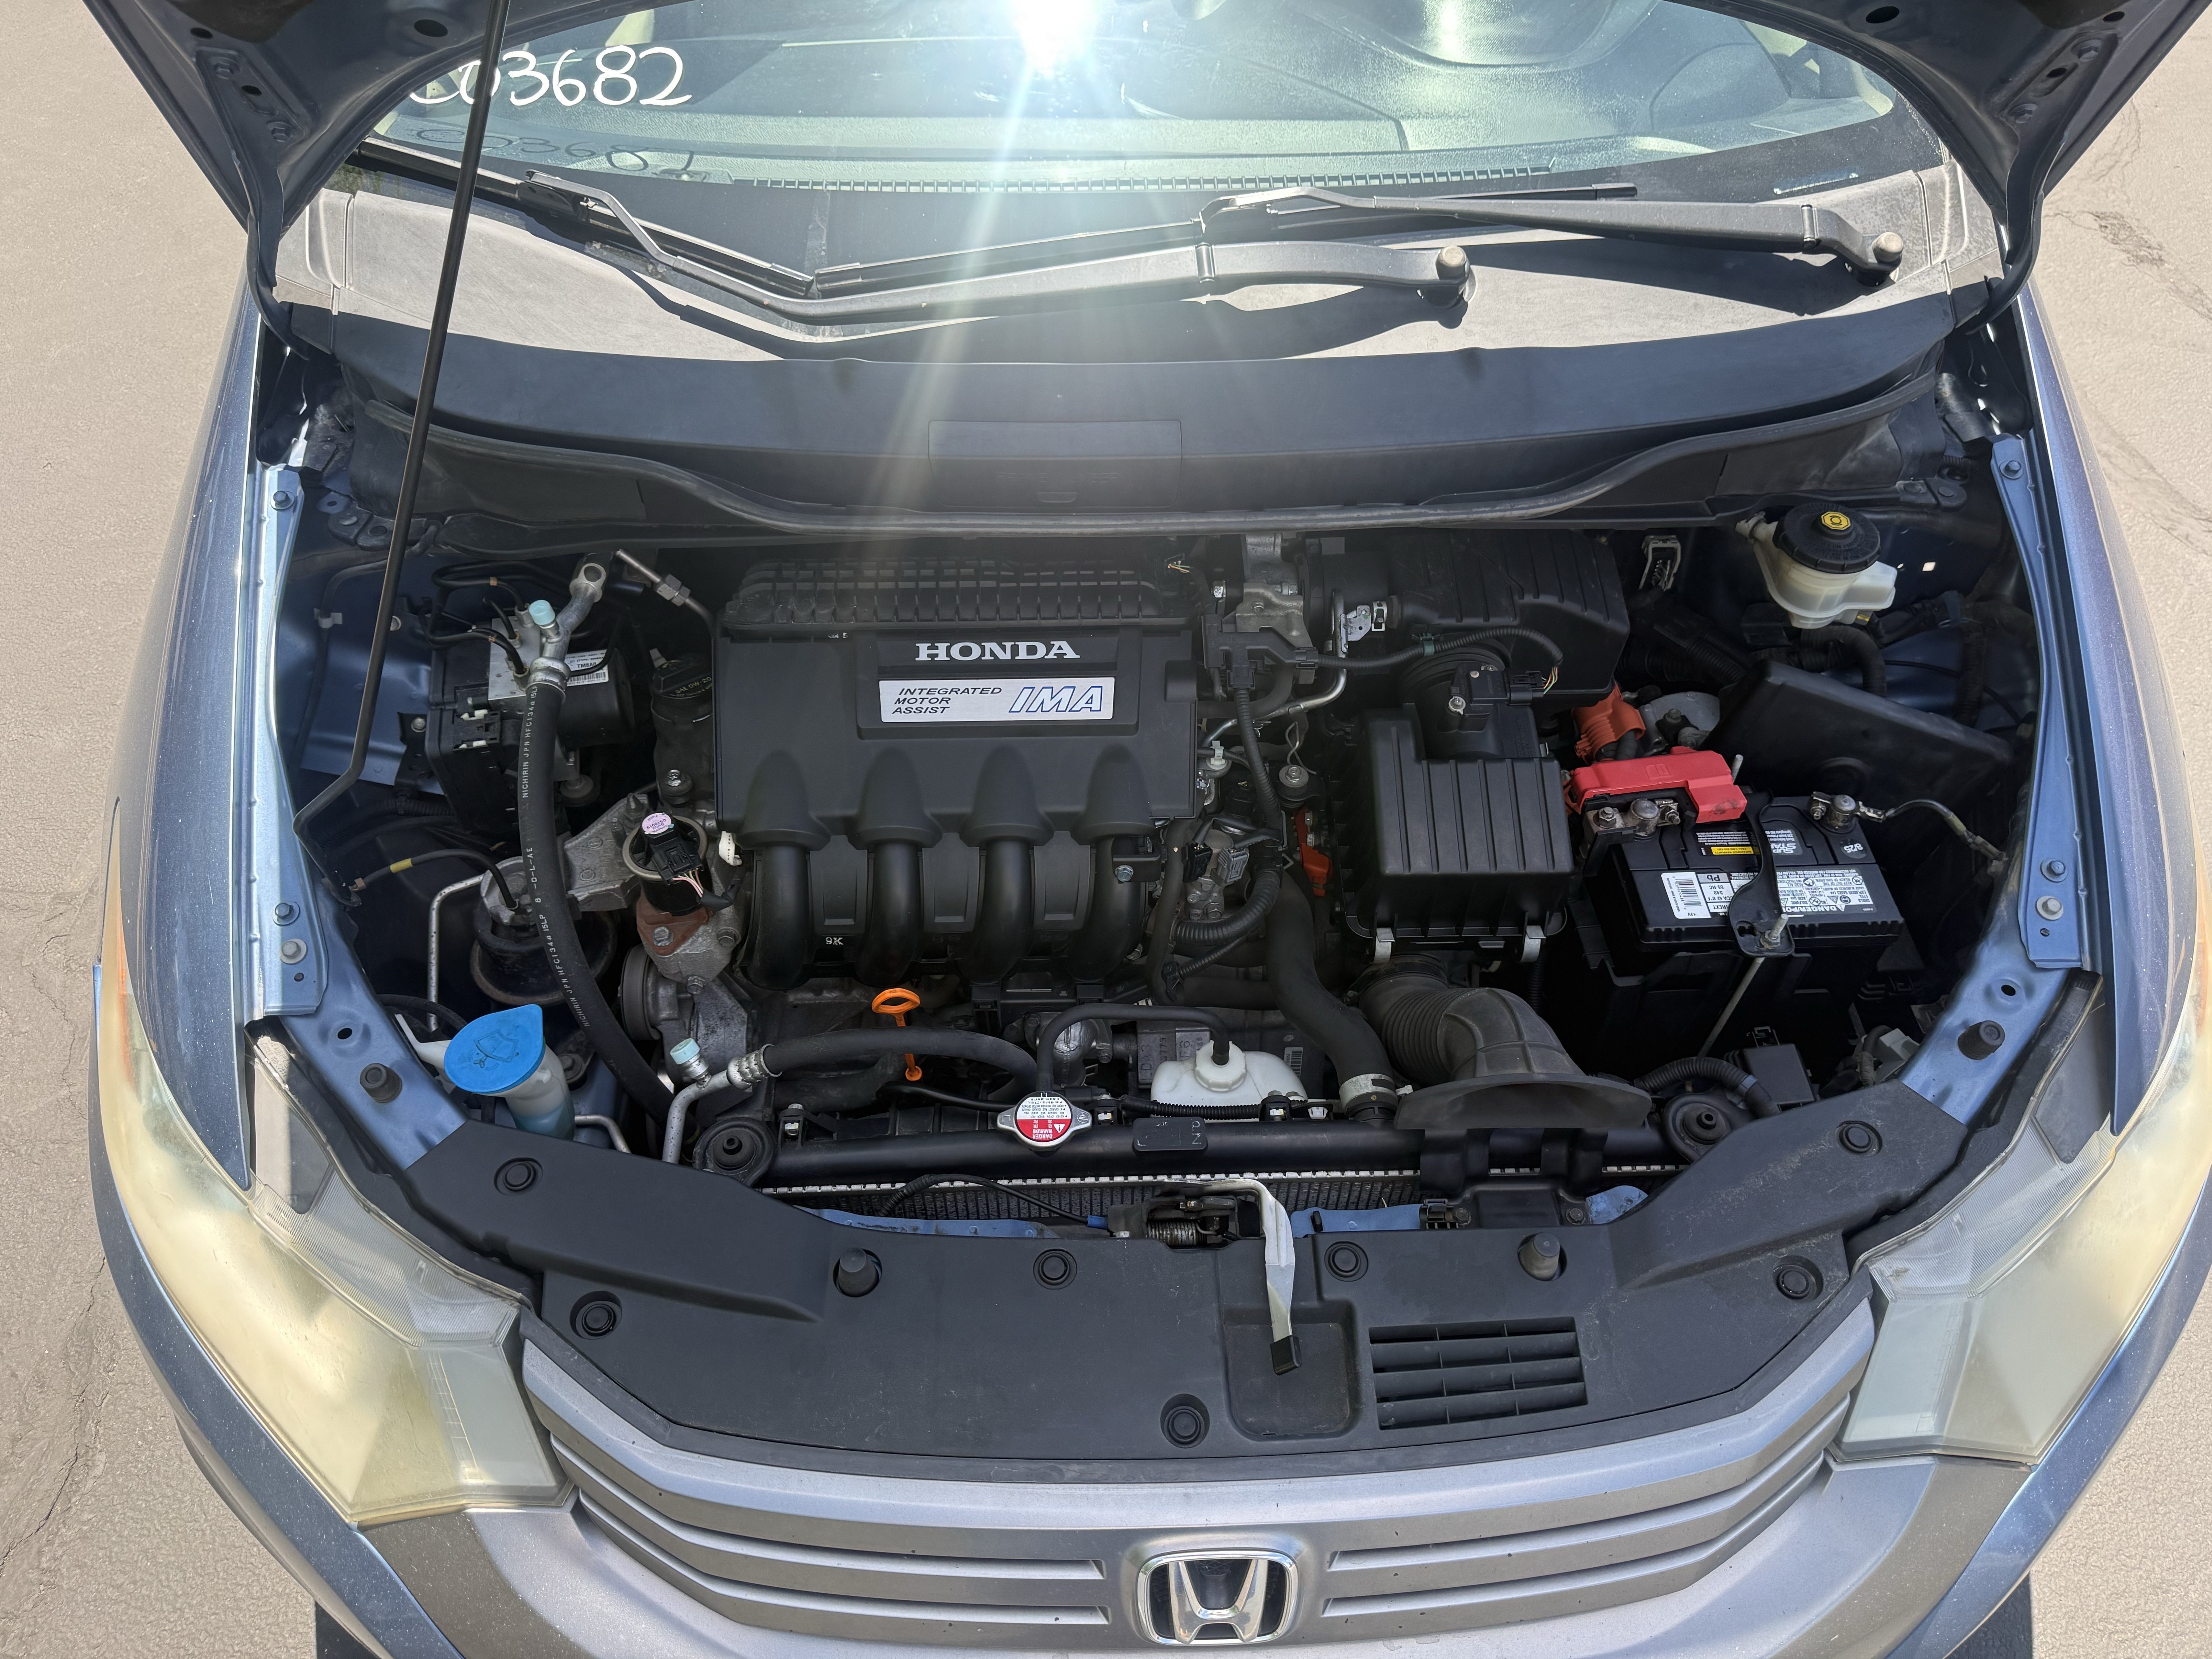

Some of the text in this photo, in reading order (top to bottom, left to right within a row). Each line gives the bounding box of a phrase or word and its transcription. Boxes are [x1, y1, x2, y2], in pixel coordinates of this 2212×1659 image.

[409, 45, 692, 106] 03682
[915, 641, 1080, 661] HONDA
[899, 687, 1002, 695] INTEGRATED
[1008, 685, 1103, 713] IMA
[892, 706, 950, 714] ASSIST
[539, 914, 550, 931] 15LP
[561, 978, 573, 993] JPN
[570, 997, 590, 1027] NICHIRIN
